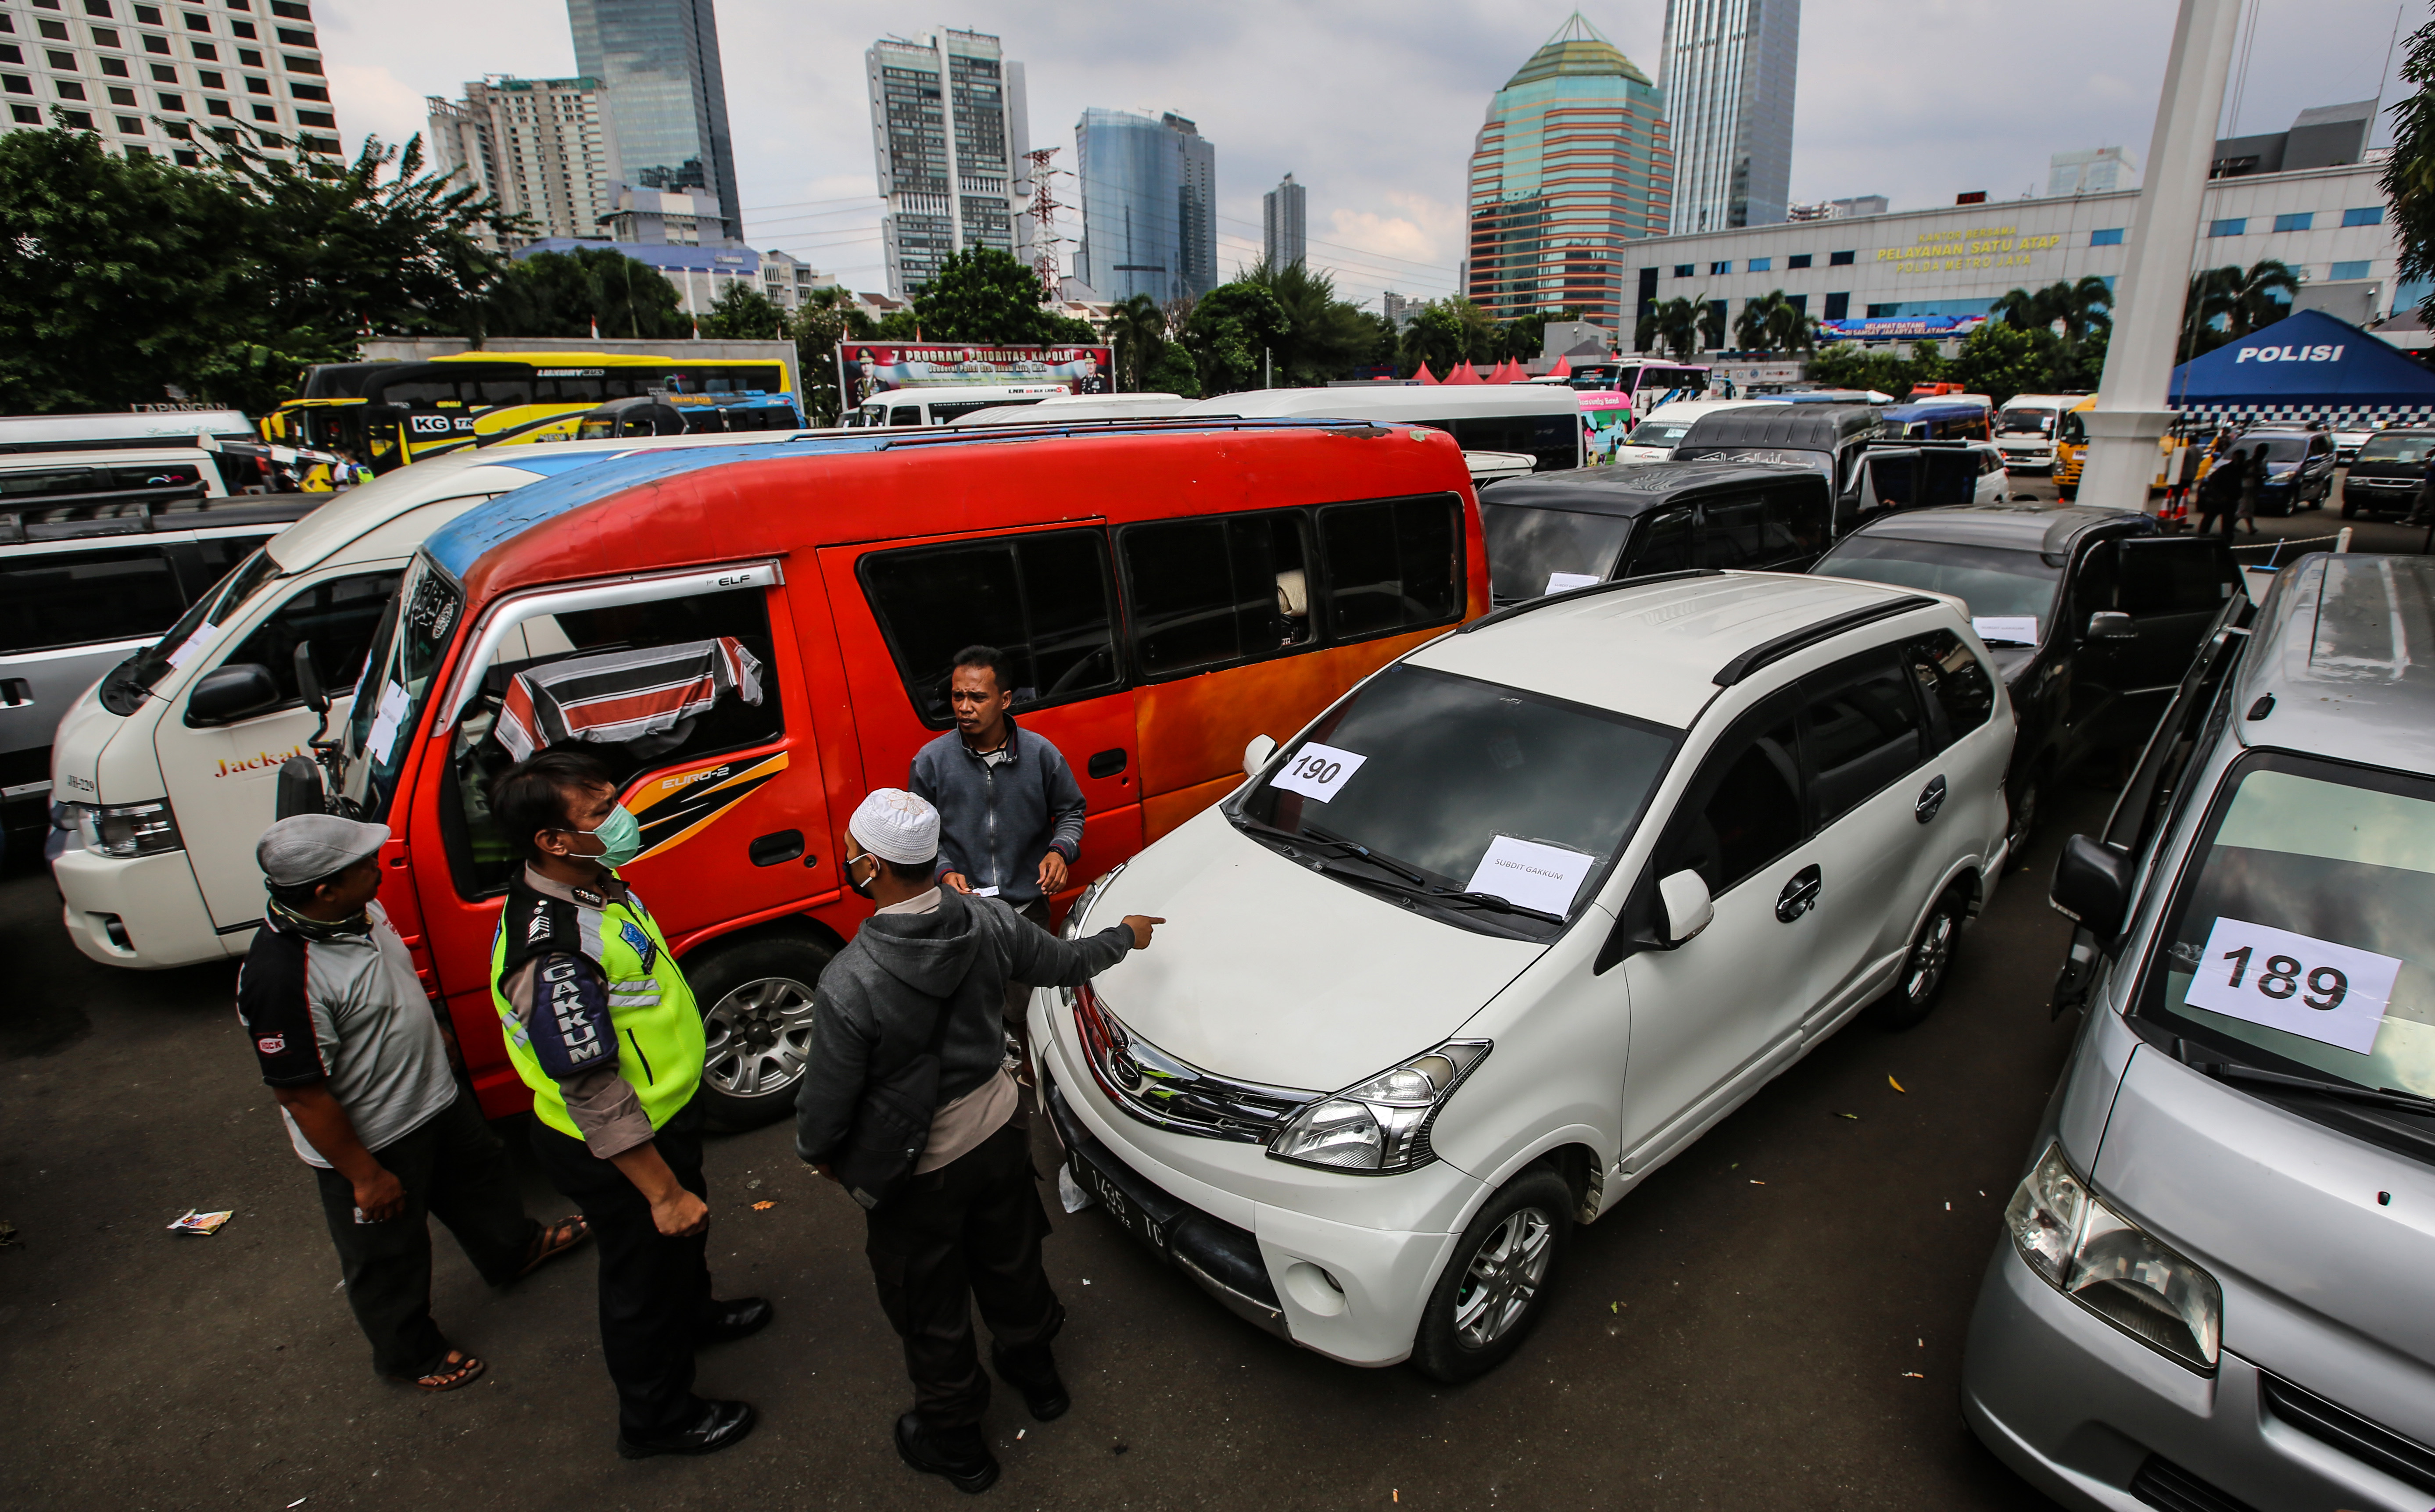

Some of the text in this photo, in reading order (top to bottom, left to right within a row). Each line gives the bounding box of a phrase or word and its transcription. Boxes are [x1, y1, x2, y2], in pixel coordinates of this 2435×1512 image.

[1919, 226, 2016, 242] KANTOR BERSAMA
[1877, 235, 2060, 261] PELAYANAN SATU ATAP
[1897, 255, 2031, 273] POLDA METRO JAYA
[892, 350, 1074, 362] 7 PROGRAM PRIORITAS KAPOLRI
[2235, 345, 2345, 364] POLISI
[412, 416, 449, 432] KG
[719, 574, 750, 586] ELF
[215, 745, 301, 778] Jackal
[1292, 755, 1341, 784] 190
[67, 775, 94, 792] JH-229
[662, 767, 729, 789] EURO-2
[1495, 858, 1564, 880] SUBDIT GAKKUM
[528, 933, 550, 944] POLISI
[2223, 946, 2349, 1011] 189
[542, 963, 602, 1065] GAKKUM
[1071, 1150, 1079, 1172] T
[1093, 1170, 1125, 1214] 1435
